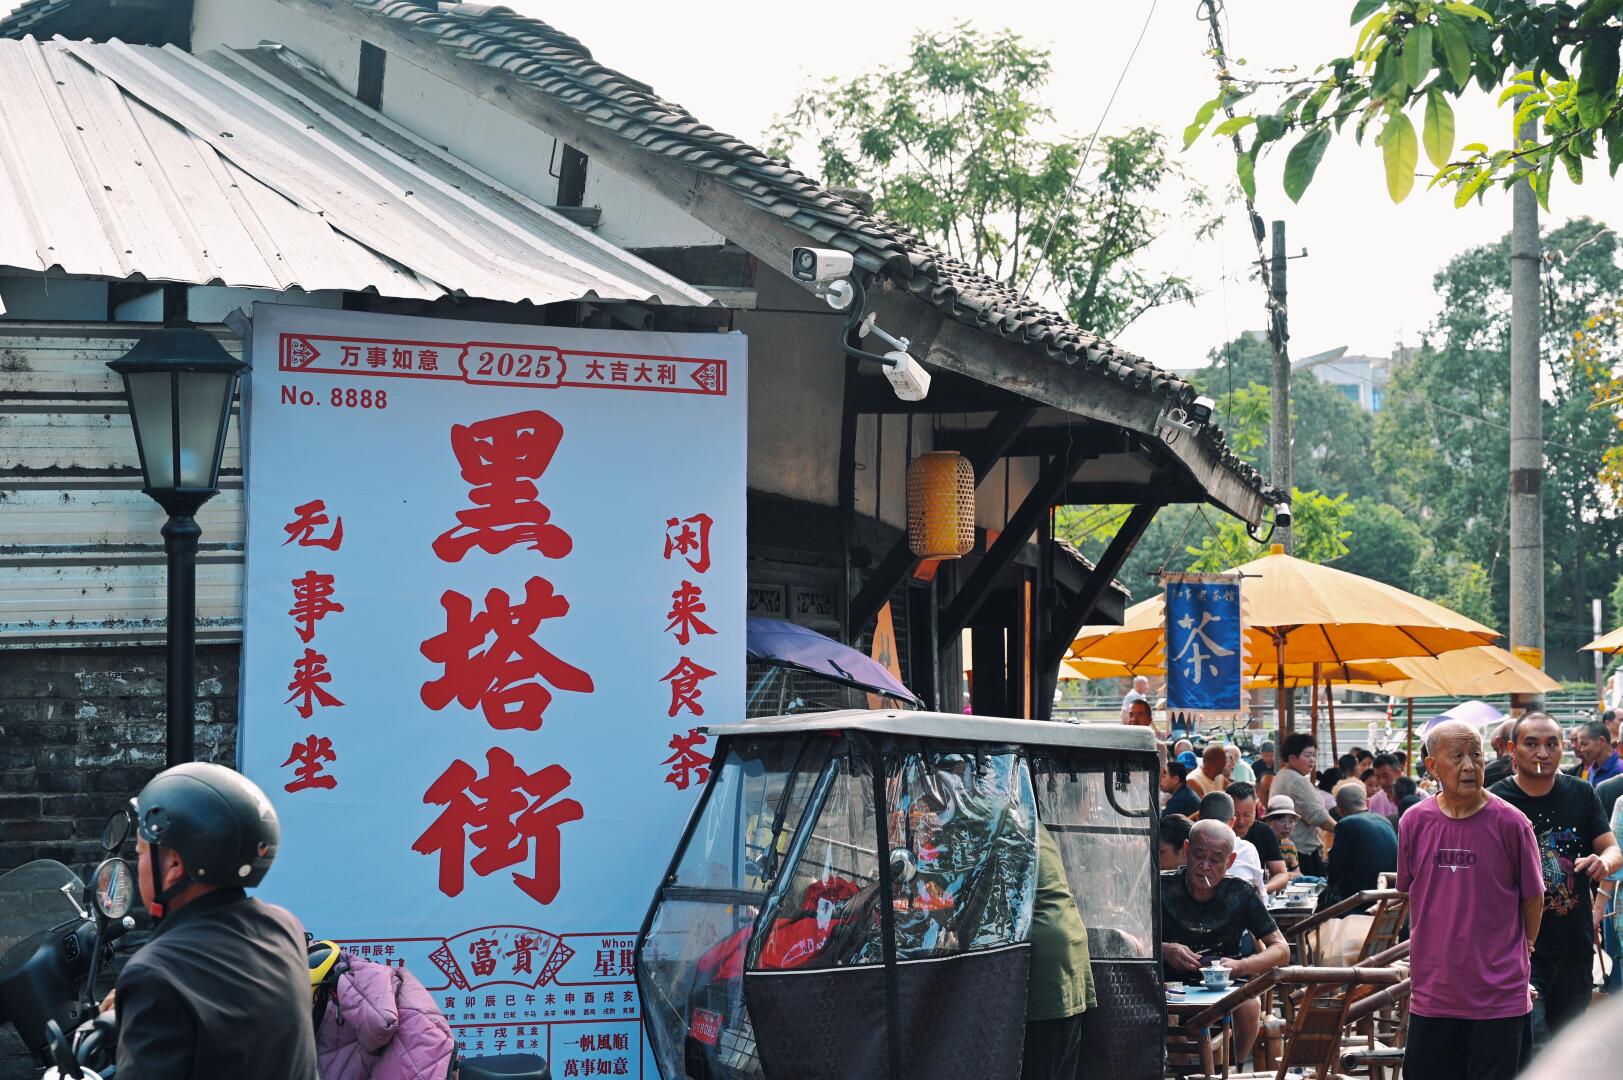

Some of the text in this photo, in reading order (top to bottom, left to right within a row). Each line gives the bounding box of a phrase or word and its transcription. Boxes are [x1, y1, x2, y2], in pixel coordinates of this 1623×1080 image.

[340, 346, 677, 385] 万事如意 2025 大吉大利
[281, 384, 388, 409] No. 8888
[280, 499, 346, 793] 无事来坐
[411, 409, 595, 905] 黑塔街
[658, 512, 718, 790] 闲来食茶
[1174, 612, 1235, 685] 茶
[469, 934, 539, 976] 富貴
[563, 1032, 629, 1052] 一帆風順
[563, 1056, 630, 1078] 萬事如意
